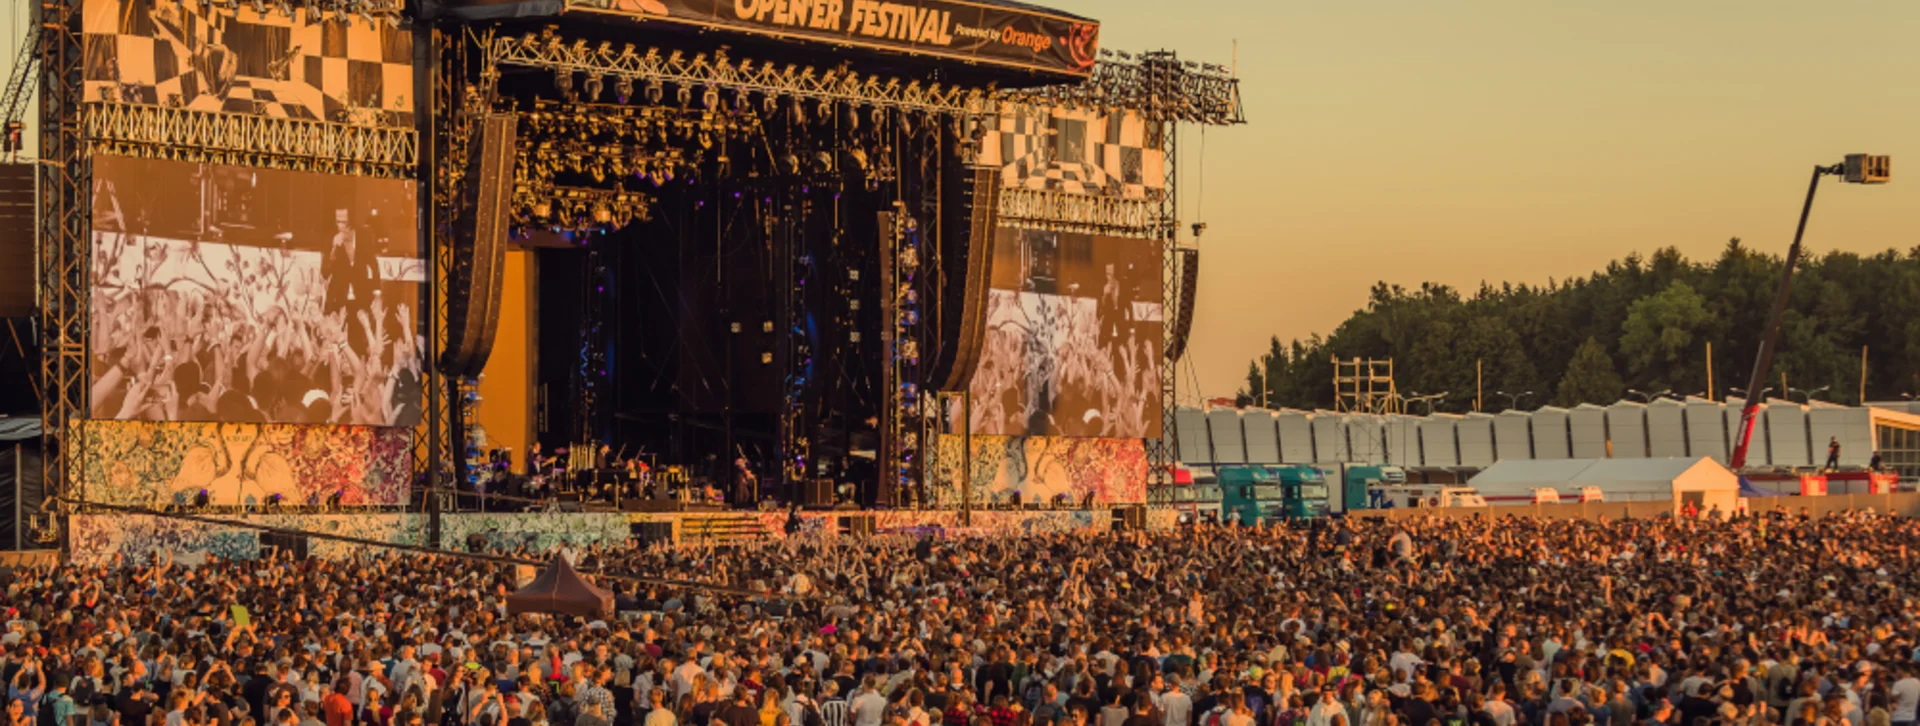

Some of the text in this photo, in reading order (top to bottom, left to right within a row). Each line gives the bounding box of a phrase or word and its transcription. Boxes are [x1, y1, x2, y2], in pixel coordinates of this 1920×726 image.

[847, 0, 953, 46] FESTIVAL
[954, 23, 1052, 52] Powered by Orange
